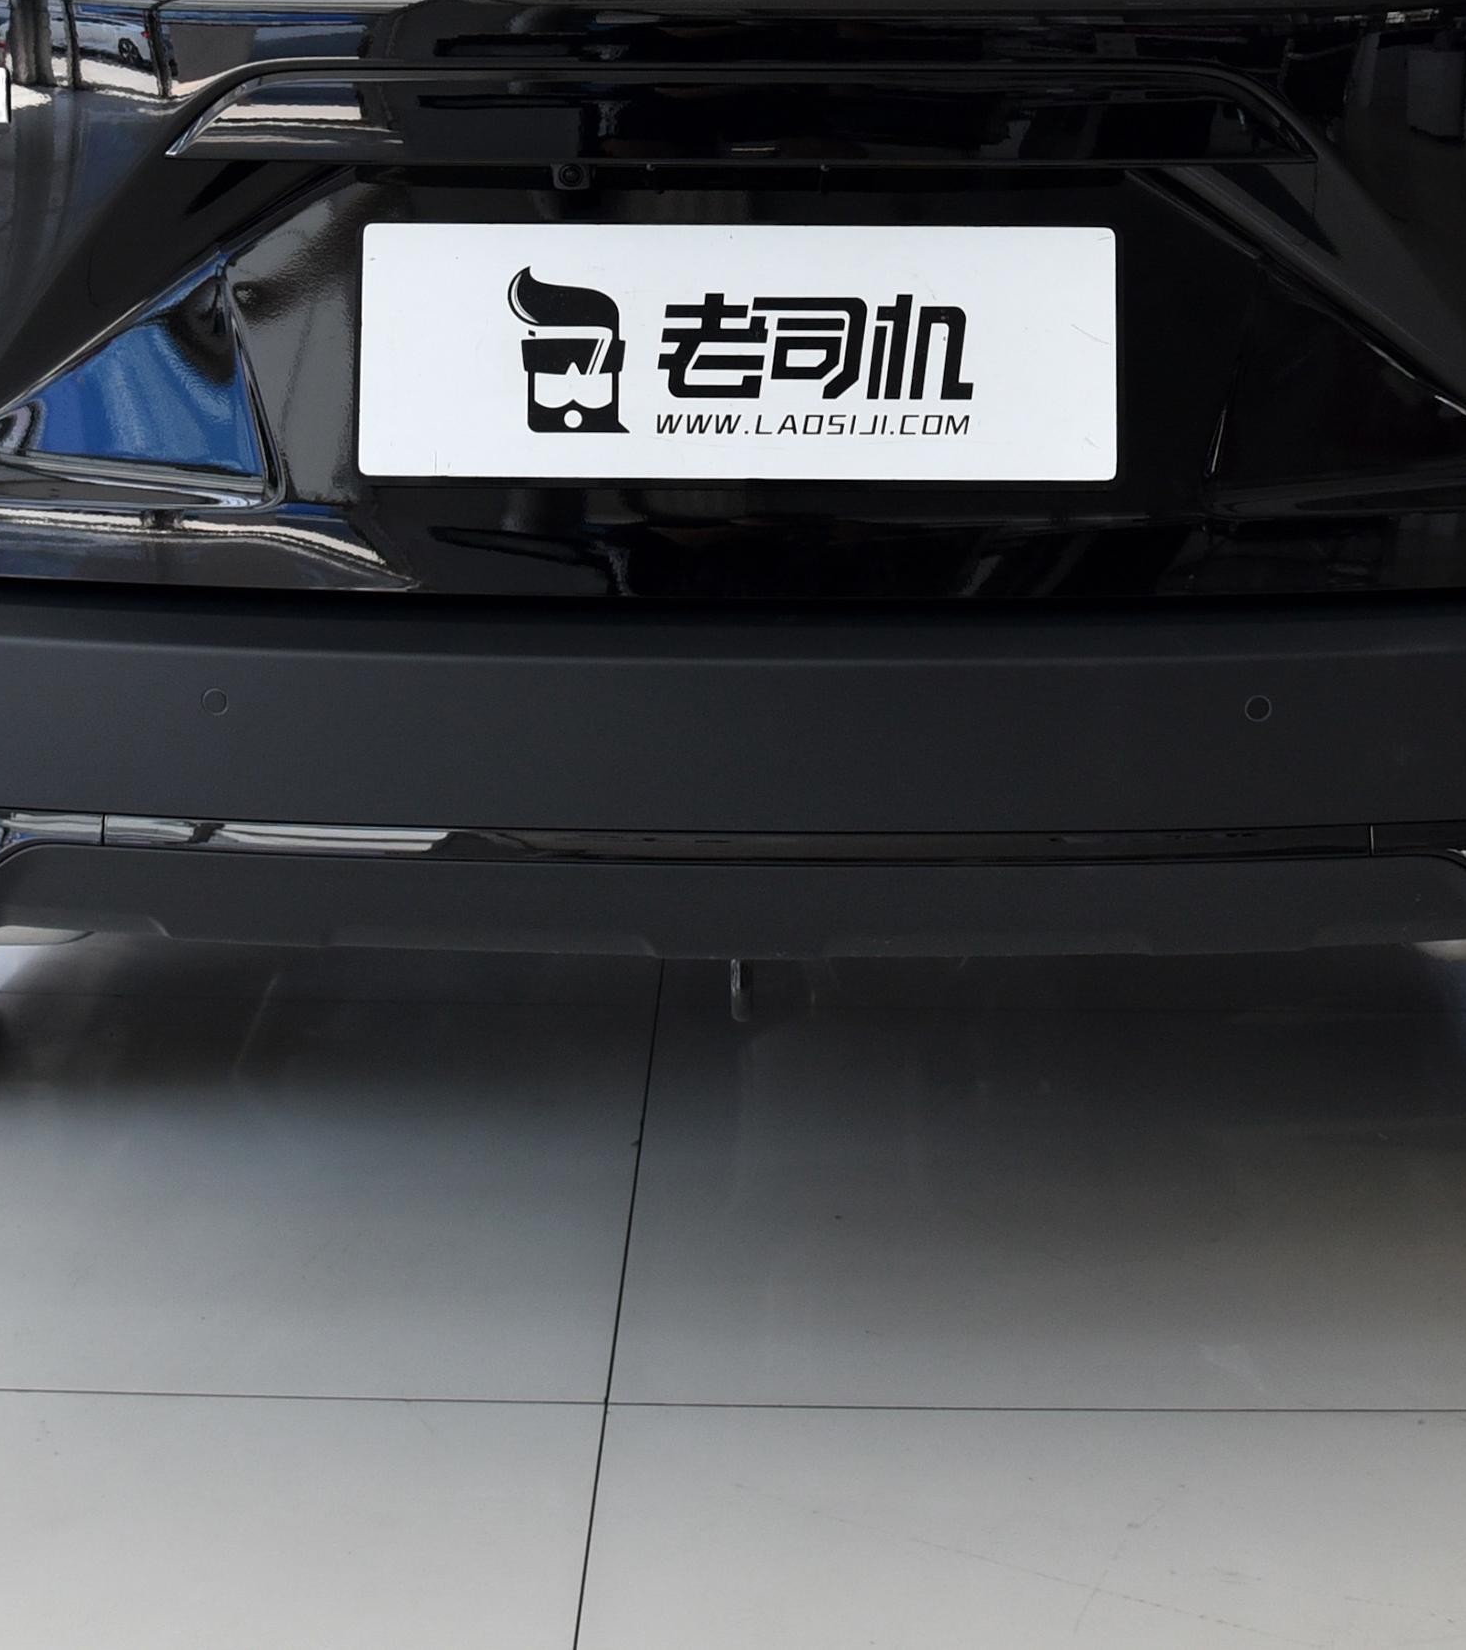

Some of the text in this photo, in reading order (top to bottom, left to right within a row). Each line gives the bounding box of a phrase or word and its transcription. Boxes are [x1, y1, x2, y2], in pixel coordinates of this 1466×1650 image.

[657, 293, 974, 400] 老司机
[655, 413, 970, 436] WWW.LAOSIJI.COM
